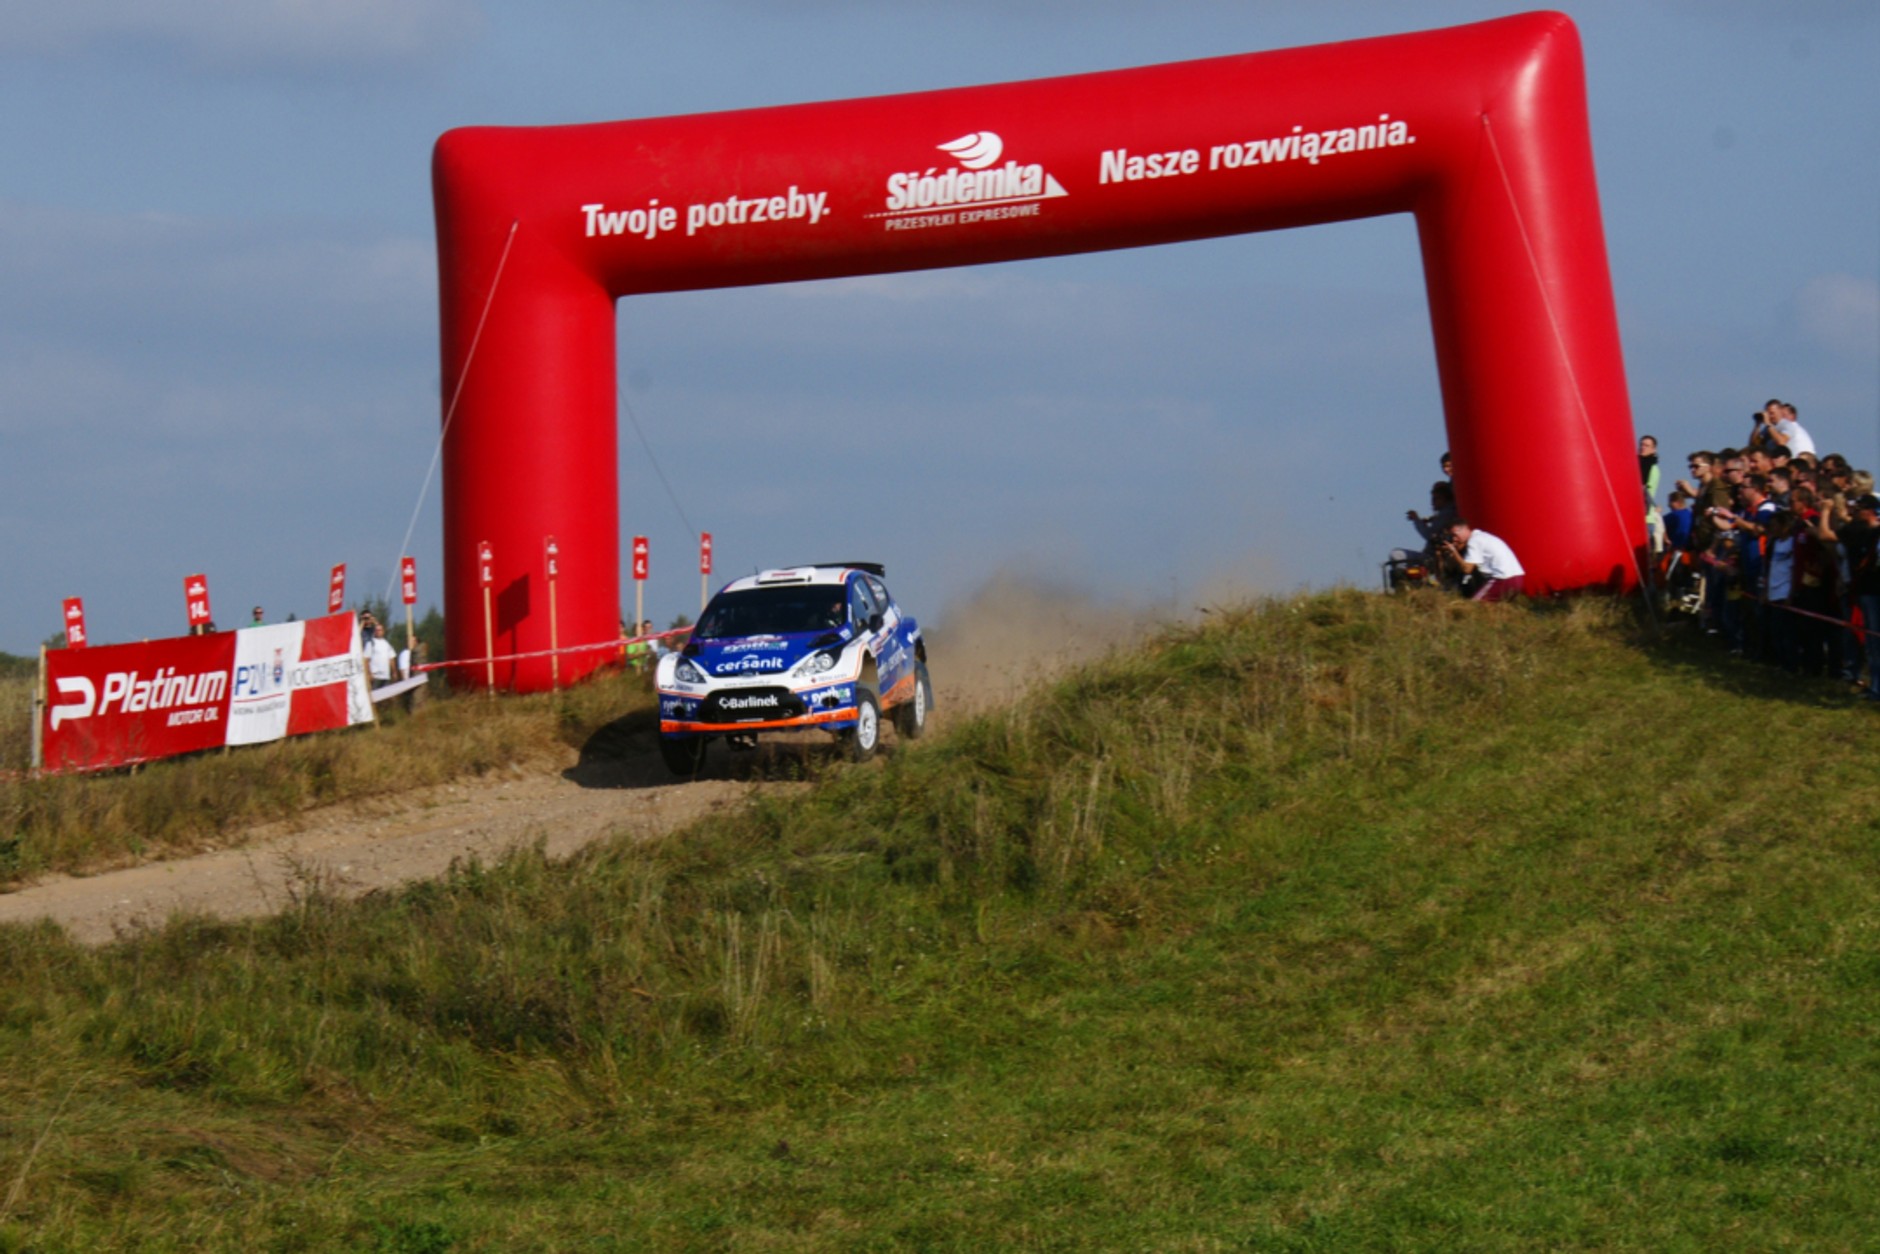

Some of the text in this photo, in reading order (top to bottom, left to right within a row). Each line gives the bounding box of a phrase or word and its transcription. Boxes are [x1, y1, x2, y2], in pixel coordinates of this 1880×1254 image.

[1099, 113, 1416, 184] Nasze rozwiązania.
[886, 161, 1043, 210] Siódemka
[581, 186, 830, 240] Twoje potrzeby.
[885, 203, 1041, 231] PRZESYŁKI EXPRESOWE
[716, 657, 784, 673] cersanit
[97, 666, 228, 716] Platinum
[729, 694, 780, 710] Barlinek
